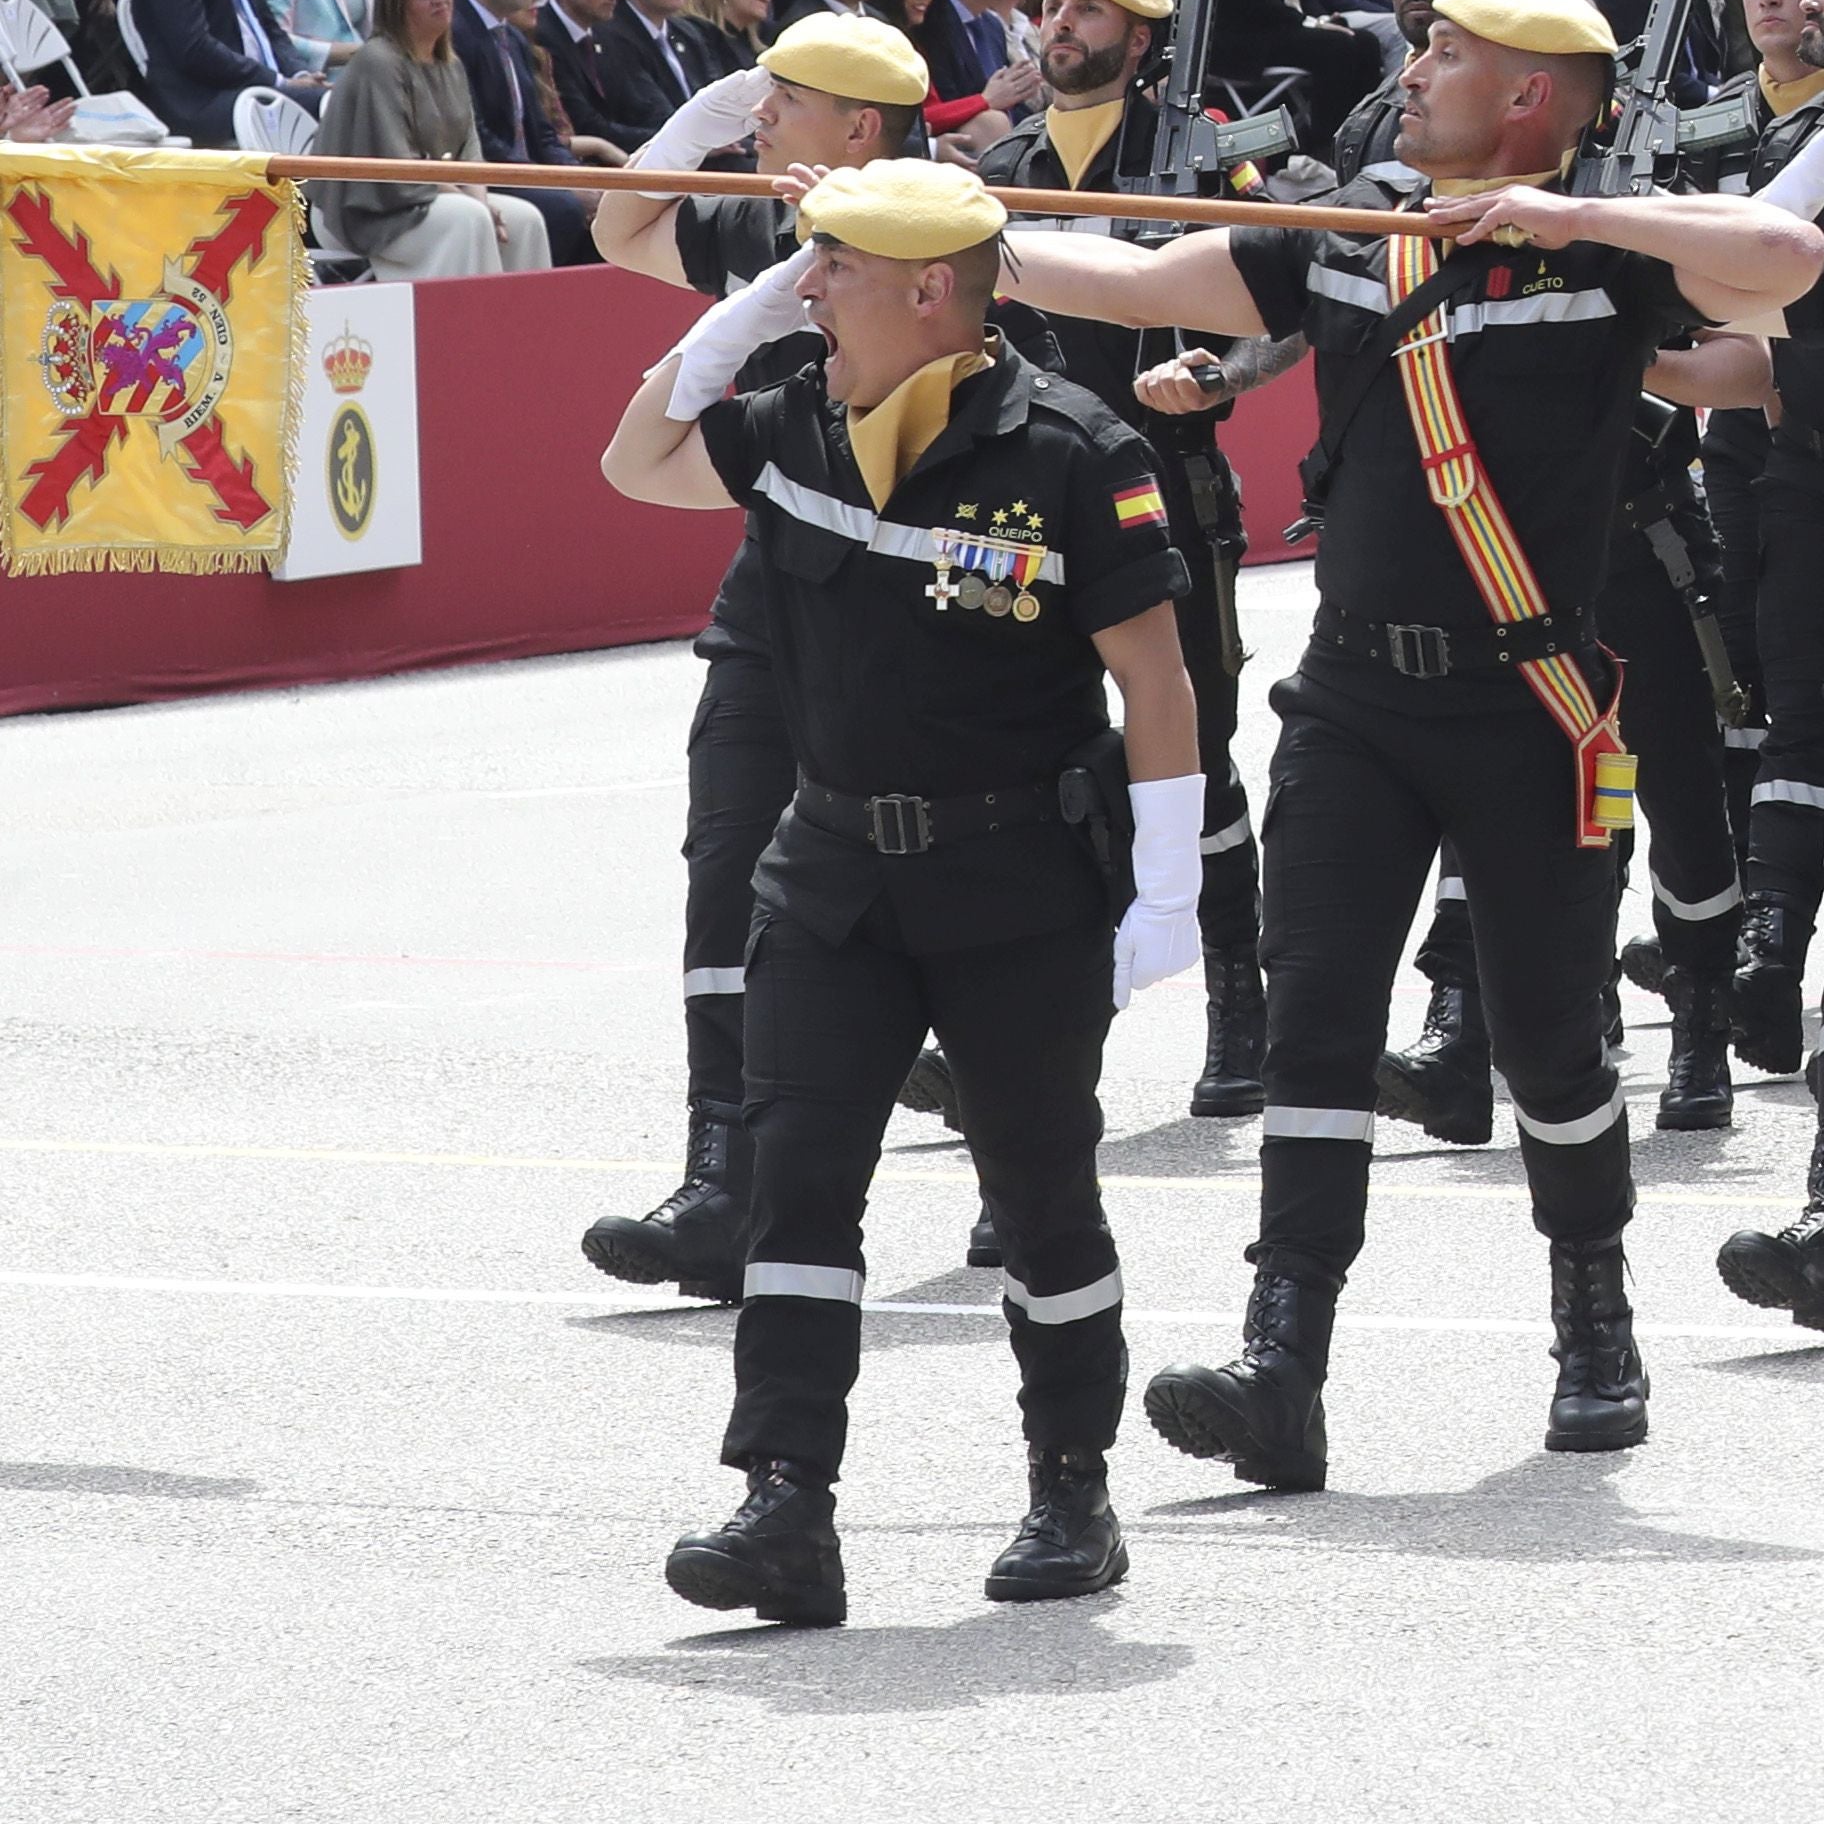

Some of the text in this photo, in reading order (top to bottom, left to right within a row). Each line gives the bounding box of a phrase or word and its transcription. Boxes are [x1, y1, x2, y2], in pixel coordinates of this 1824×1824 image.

[1522, 277, 1563, 294] CUETO
[191, 287, 207, 303] 52
[988, 526, 1043, 543] QUEIPO
